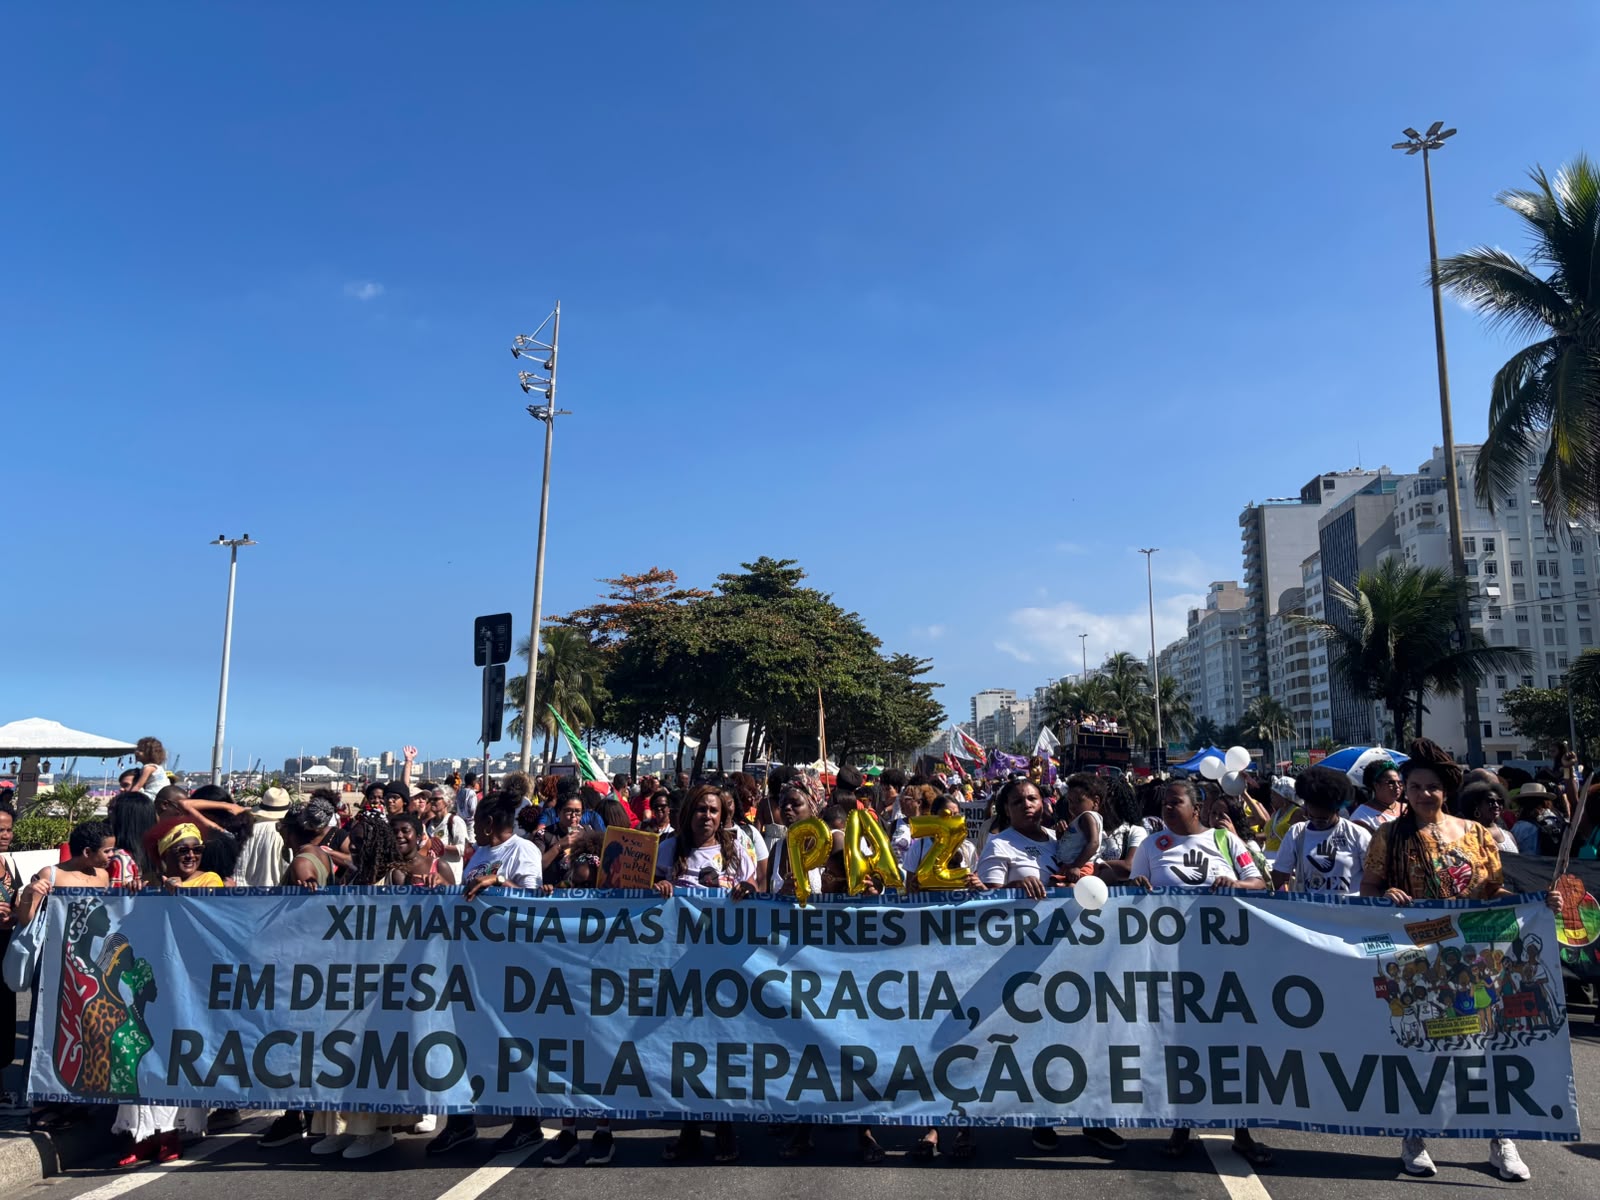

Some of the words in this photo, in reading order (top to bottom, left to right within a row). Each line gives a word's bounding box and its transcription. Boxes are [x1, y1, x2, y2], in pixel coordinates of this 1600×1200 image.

[624, 846, 651, 861] Negra
[787, 809, 970, 906] PAZ
[323, 905, 376, 941] XII
[387, 905, 569, 943] MARCHA
[579, 907, 663, 945] DAS
[677, 907, 908, 946] MULHERES
[919, 908, 1104, 946] NEGRAS
[1119, 907, 1186, 945] DO
[1200, 907, 1249, 946] RJ
[1367, 941, 1392, 950] MATA
[208, 964, 275, 1011] EM
[290, 964, 476, 1013] DEFESA
[504, 967, 576, 1016] DA
[591, 969, 980, 1030] DEMOCRACIA,
[1001, 971, 1257, 1024] CONTRA
[1271, 975, 1325, 1029] O
[167, 1029, 484, 1103] RACISMO,
[497, 1038, 653, 1099] PELA
[671, 1034, 1088, 1121] REPARAÇÃO
[1109, 1046, 1144, 1104] E
[1165, 1046, 1310, 1109] BEM
[1319, 1053, 1564, 1120] VIVER.
